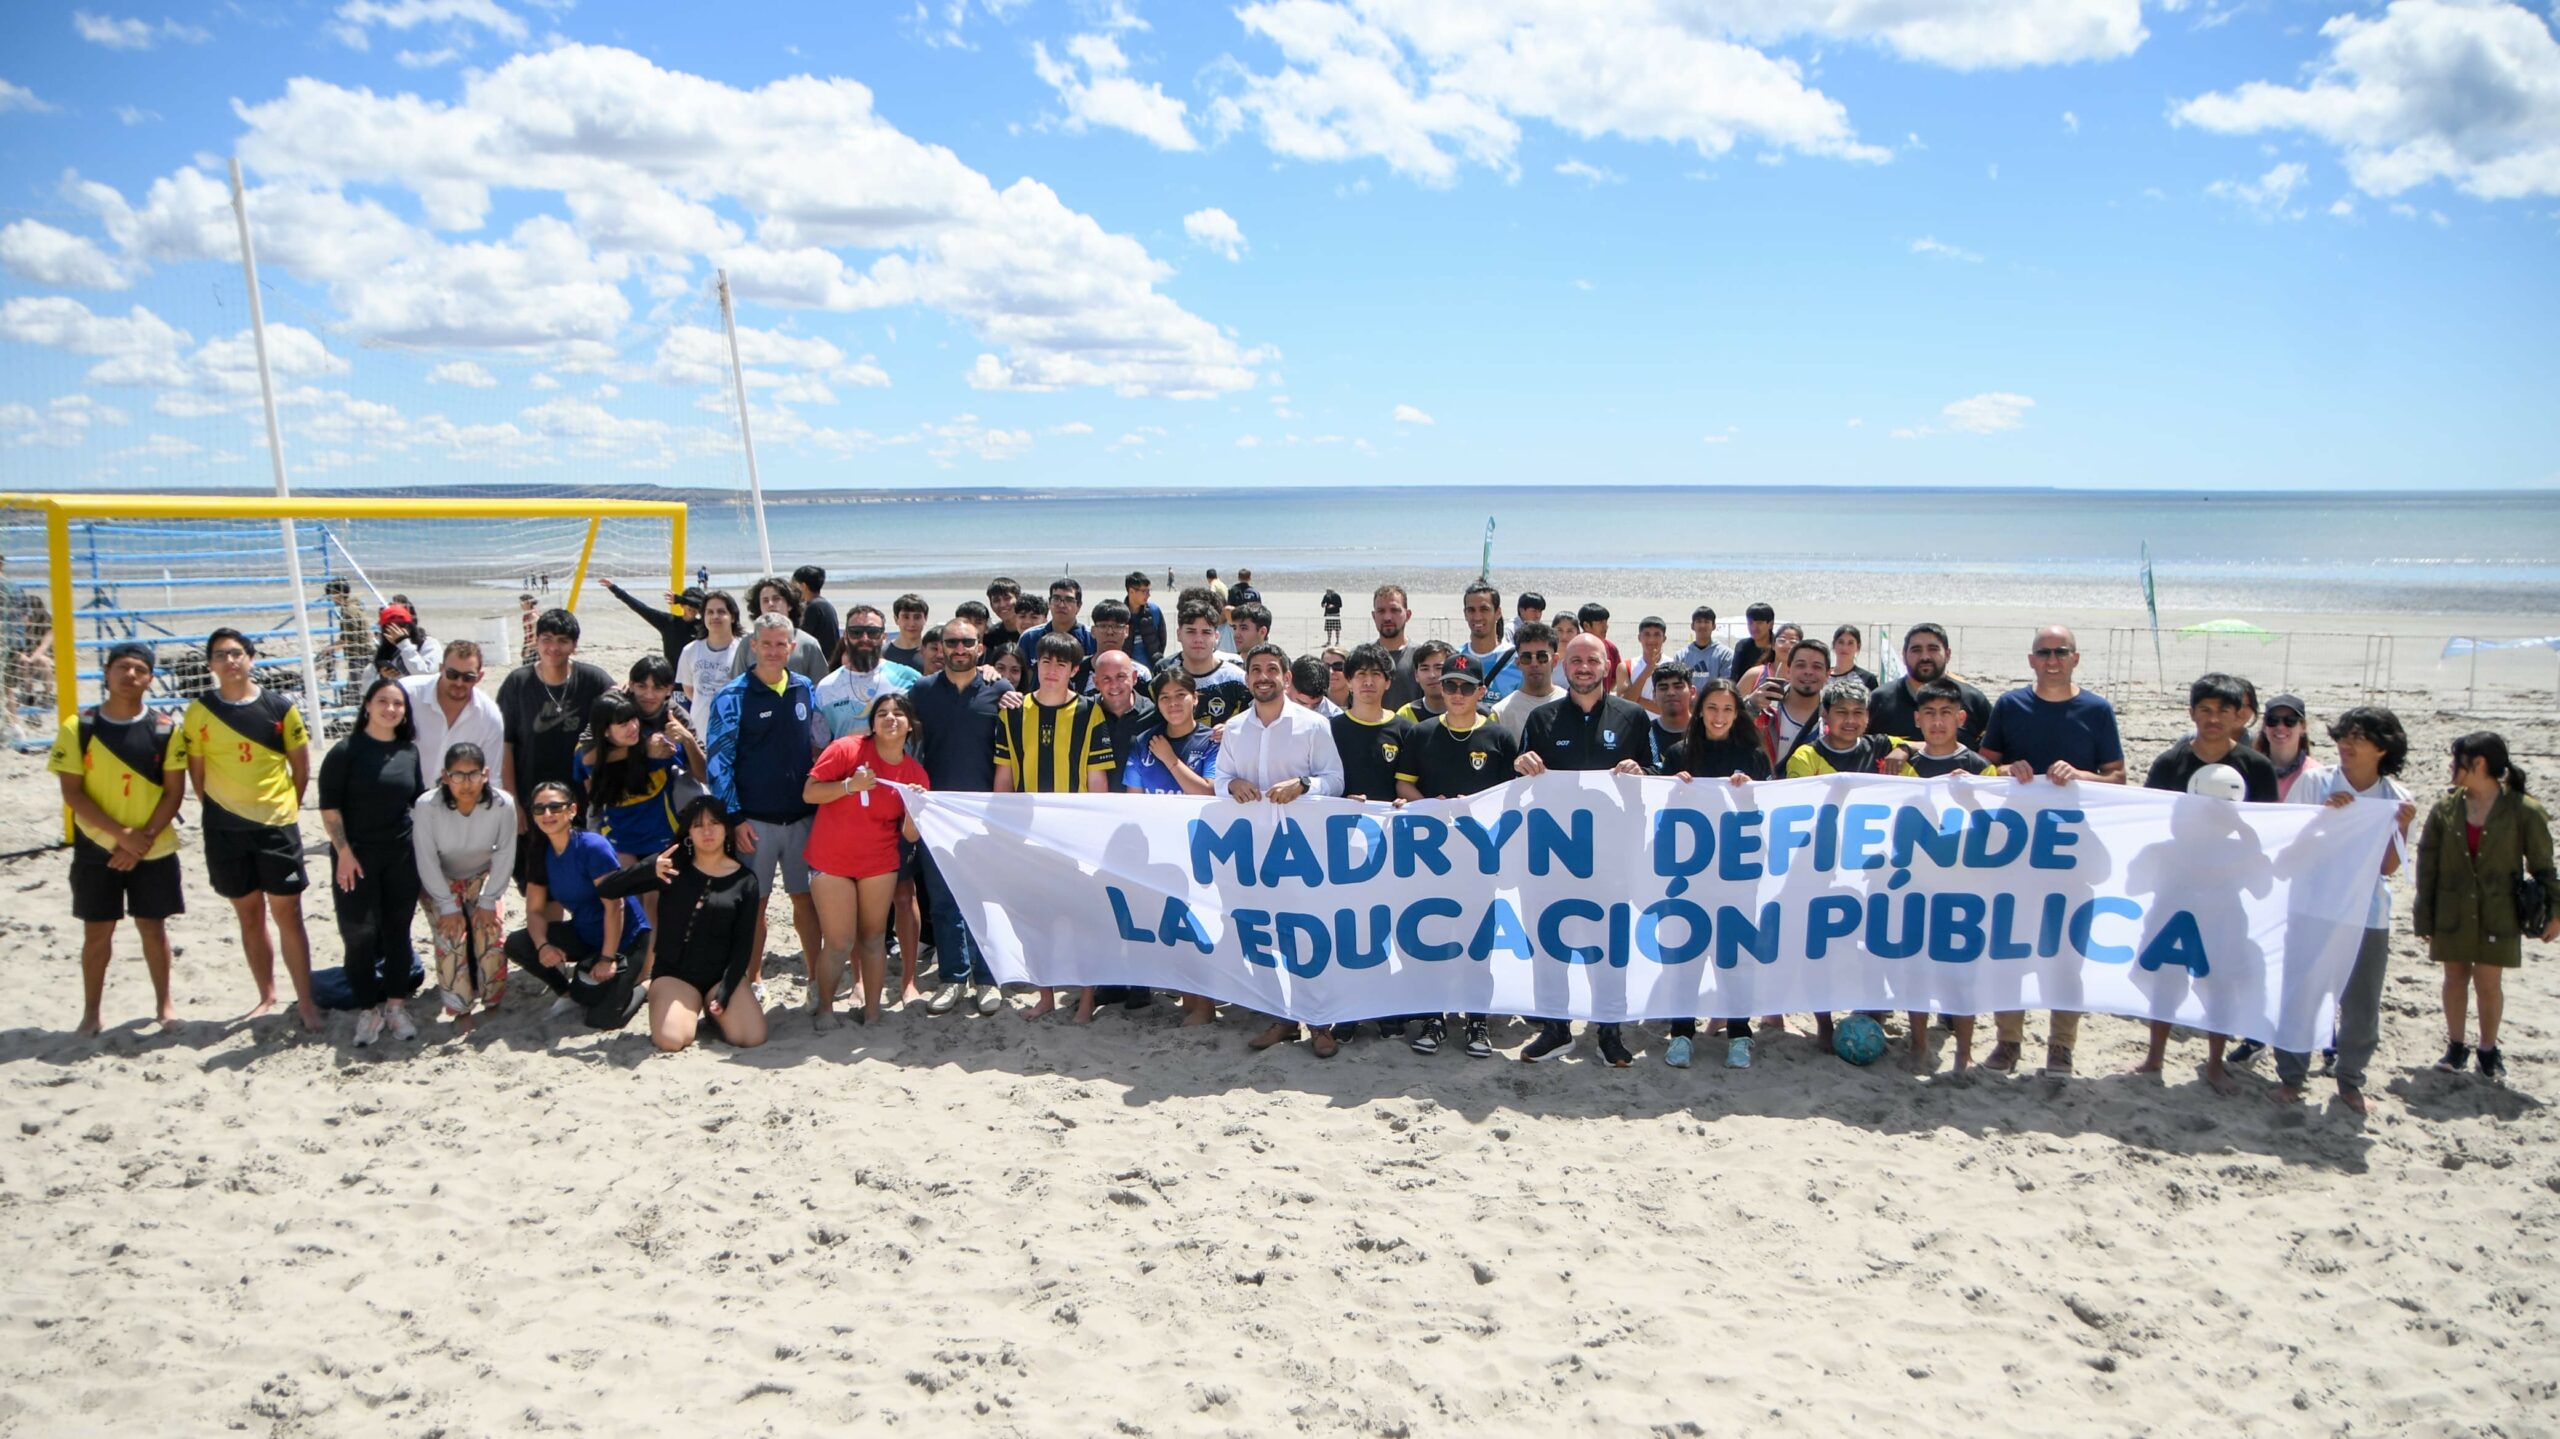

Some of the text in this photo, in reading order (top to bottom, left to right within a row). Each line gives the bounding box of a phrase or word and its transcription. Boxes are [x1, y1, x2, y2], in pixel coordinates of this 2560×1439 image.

[239, 743, 252, 762] 3
[122, 773, 132, 796] 7
[1187, 804, 2085, 888] MADRYN DEFIENDE
[1106, 869, 2210, 979] LA EDUCACIÓN PÚBLICA
